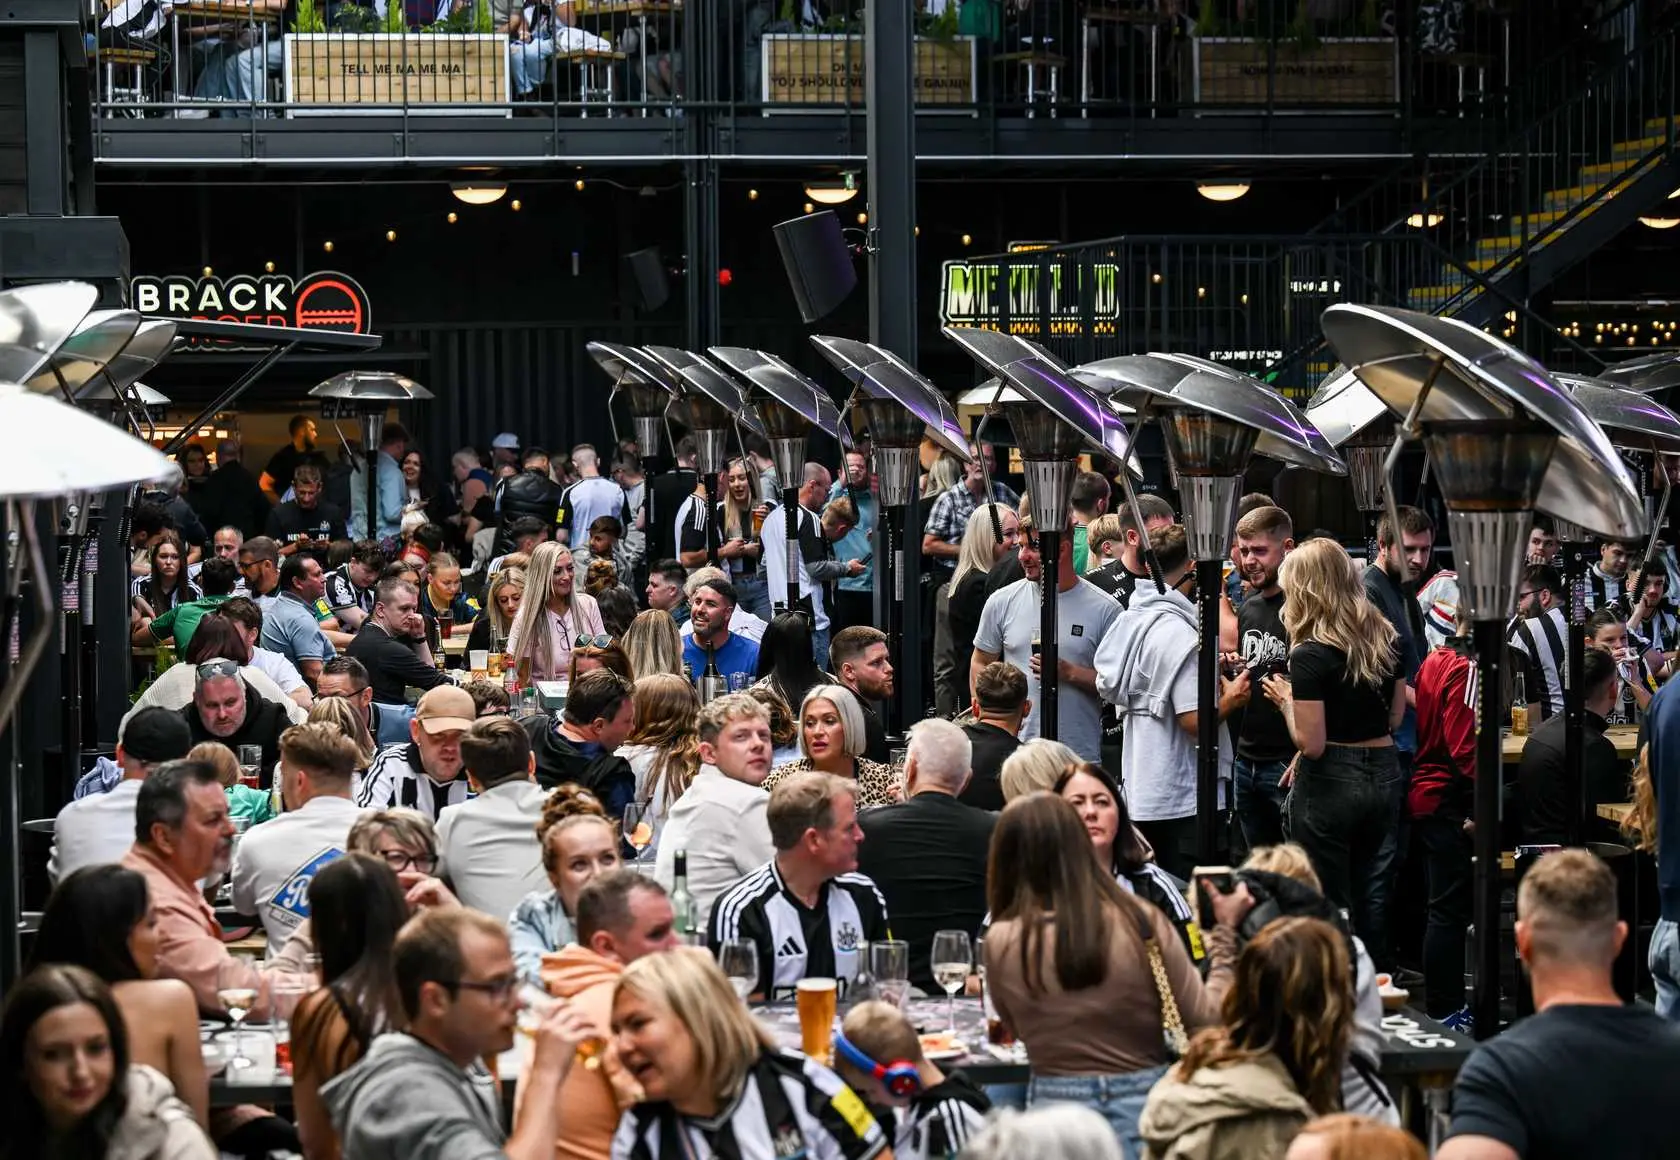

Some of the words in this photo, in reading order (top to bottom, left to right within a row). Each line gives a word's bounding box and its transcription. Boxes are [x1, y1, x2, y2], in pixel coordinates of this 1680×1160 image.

[341, 64, 369, 74] TELL
[374, 64, 391, 74] ME
[396, 64, 415, 74] MA
[420, 64, 437, 74] ME
[441, 64, 461, 74] MA
[771, 78, 796, 88] YOU
[139, 284, 286, 312] BRACK
